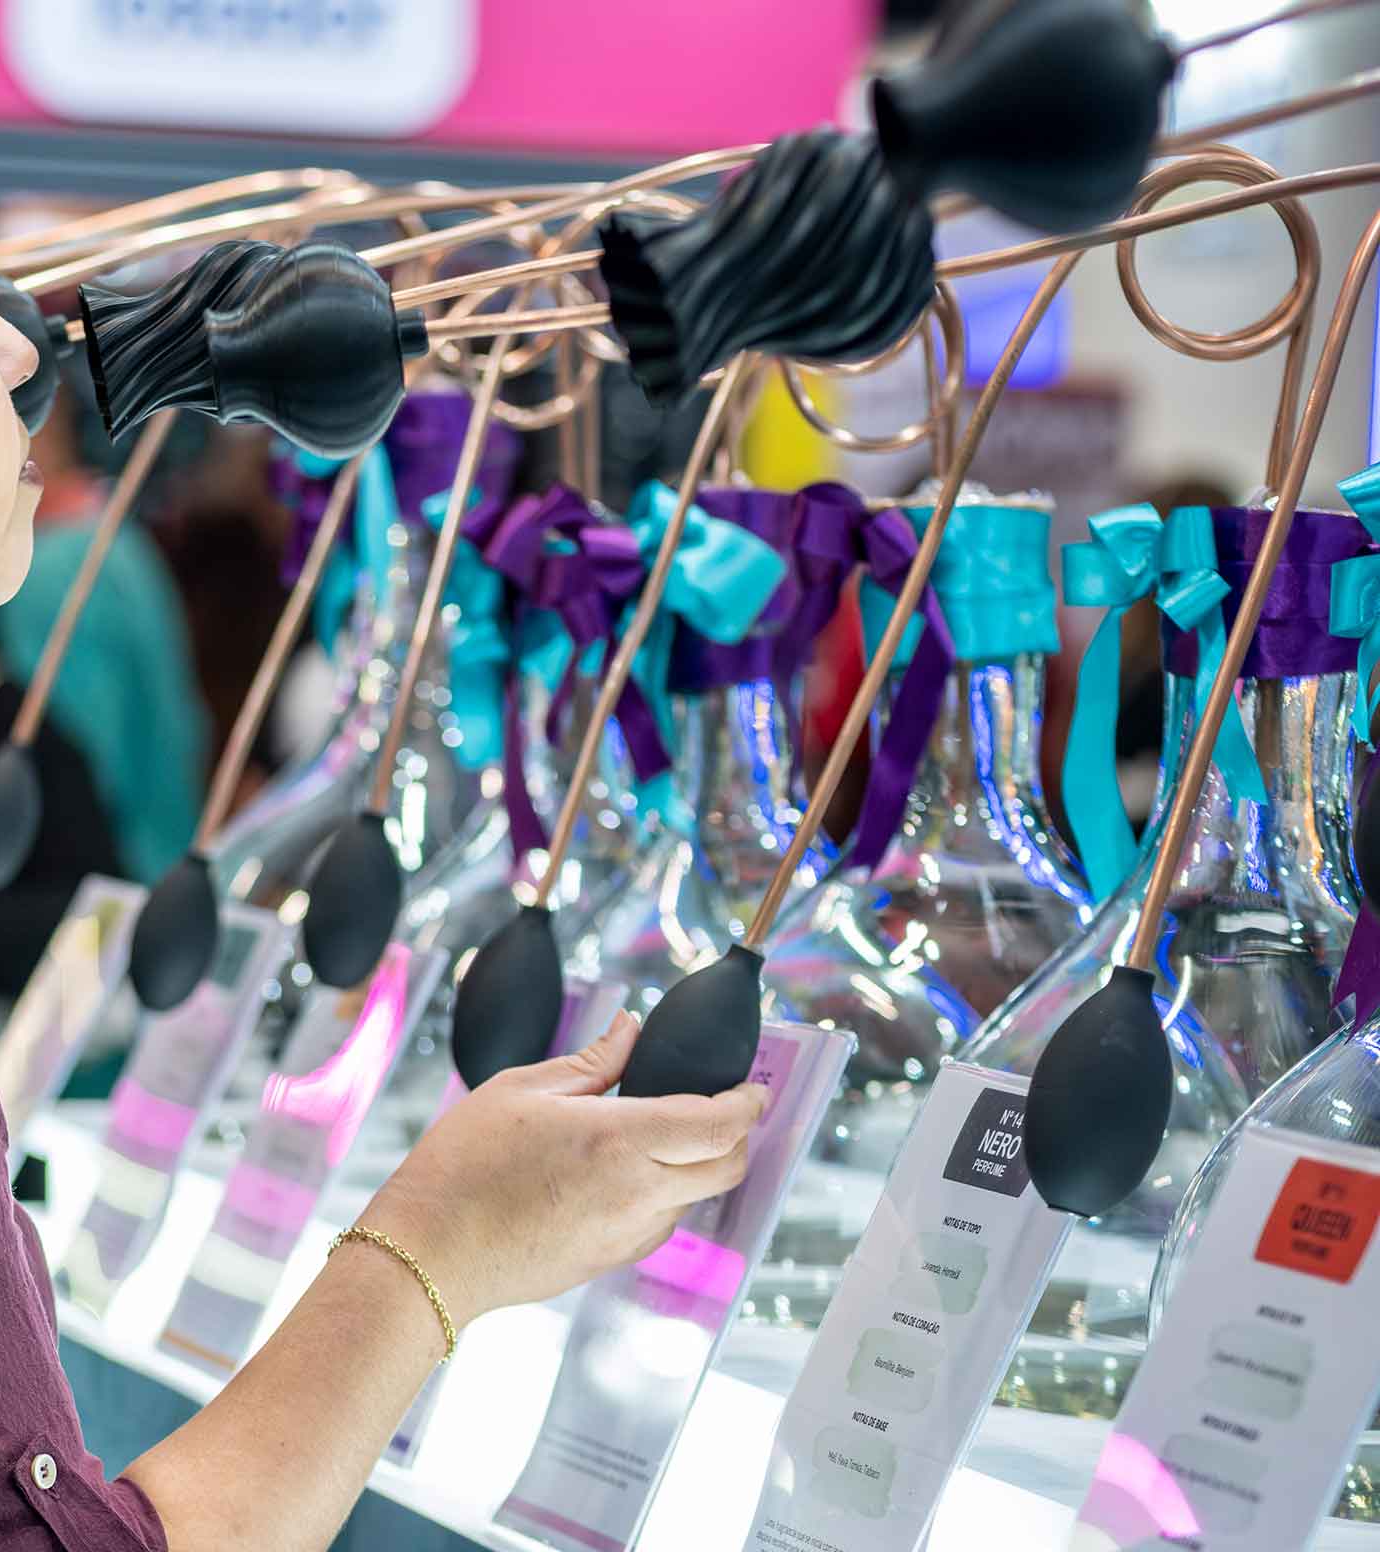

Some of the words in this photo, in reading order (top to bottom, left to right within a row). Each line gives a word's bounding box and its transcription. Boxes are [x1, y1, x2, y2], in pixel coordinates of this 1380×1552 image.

[978, 1129, 1022, 1160] NERO
[972, 1158, 1007, 1177] PERFUME
[943, 1216, 960, 1229] NOTAS
[959, 1220, 968, 1231] DE
[967, 1222, 982, 1234] TOPO
[892, 1312, 909, 1325] NOTAS
[908, 1316, 917, 1327] DE
[916, 1319, 940, 1335] CORAÇÃO
[852, 1411, 869, 1425] NOTAS
[868, 1416, 877, 1428] DE
[875, 1419, 889, 1432] BASE
